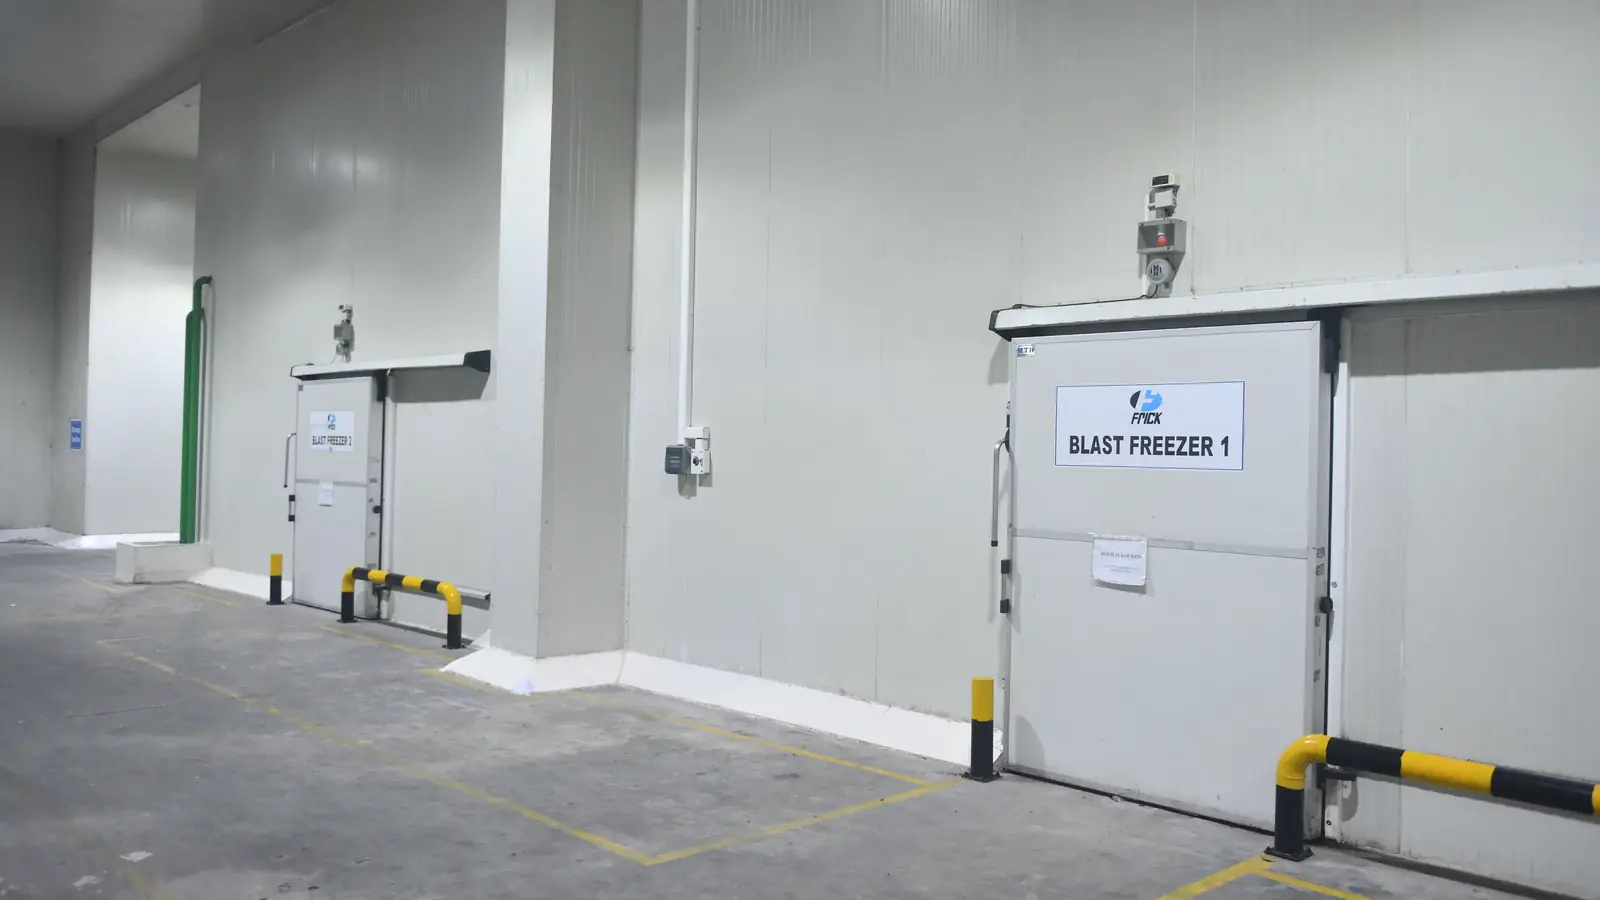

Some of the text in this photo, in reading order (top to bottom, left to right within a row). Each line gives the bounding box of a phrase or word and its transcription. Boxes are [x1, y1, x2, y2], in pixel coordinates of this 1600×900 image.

[1131, 412, 1163, 425] FRICK
[312, 436, 352, 446] BLAST FREEZER 2
[1069, 434, 1230, 457] BLAST FREEZER 1
